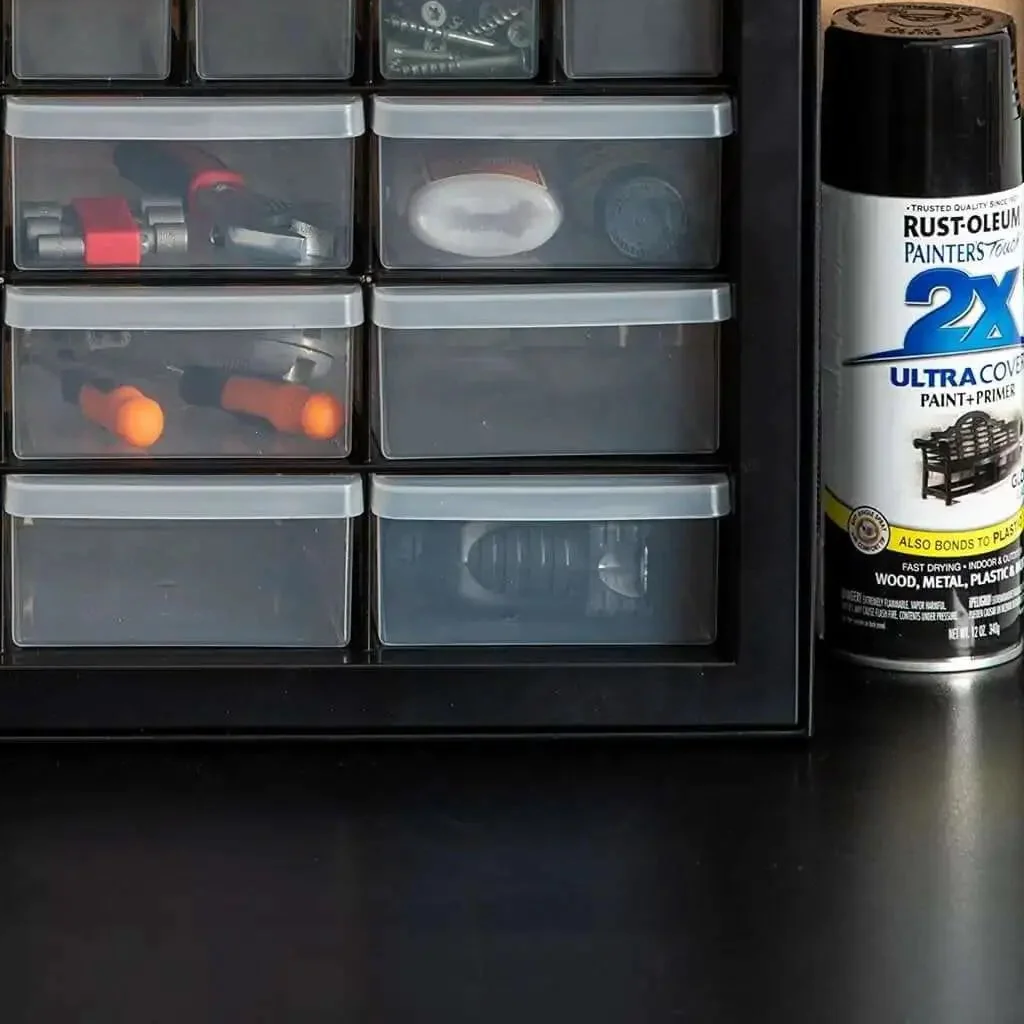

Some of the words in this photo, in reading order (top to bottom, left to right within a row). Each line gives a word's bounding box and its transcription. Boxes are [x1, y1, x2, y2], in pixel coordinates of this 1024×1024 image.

[911, 204, 952, 212] TRUSTED
[954, 202, 987, 212] QUALITY
[904, 205, 1020, 237] RUST-OLEUM
[903, 266, 1020, 356] 2X
[890, 366, 977, 388] ULTRA
[899, 536, 931, 551] ALSO
[935, 538, 975, 551] BONDS
[977, 536, 990, 547] TO
[902, 562, 925, 572] FAST
[927, 562, 962, 573] DRYING
[968, 558, 997, 570] INDOOR
[998, 556, 1003, 565] &
[875, 572, 921, 590] WOOD,
[923, 575, 969, 590] METAL,
[970, 565, 1010, 587] PLASTIC
